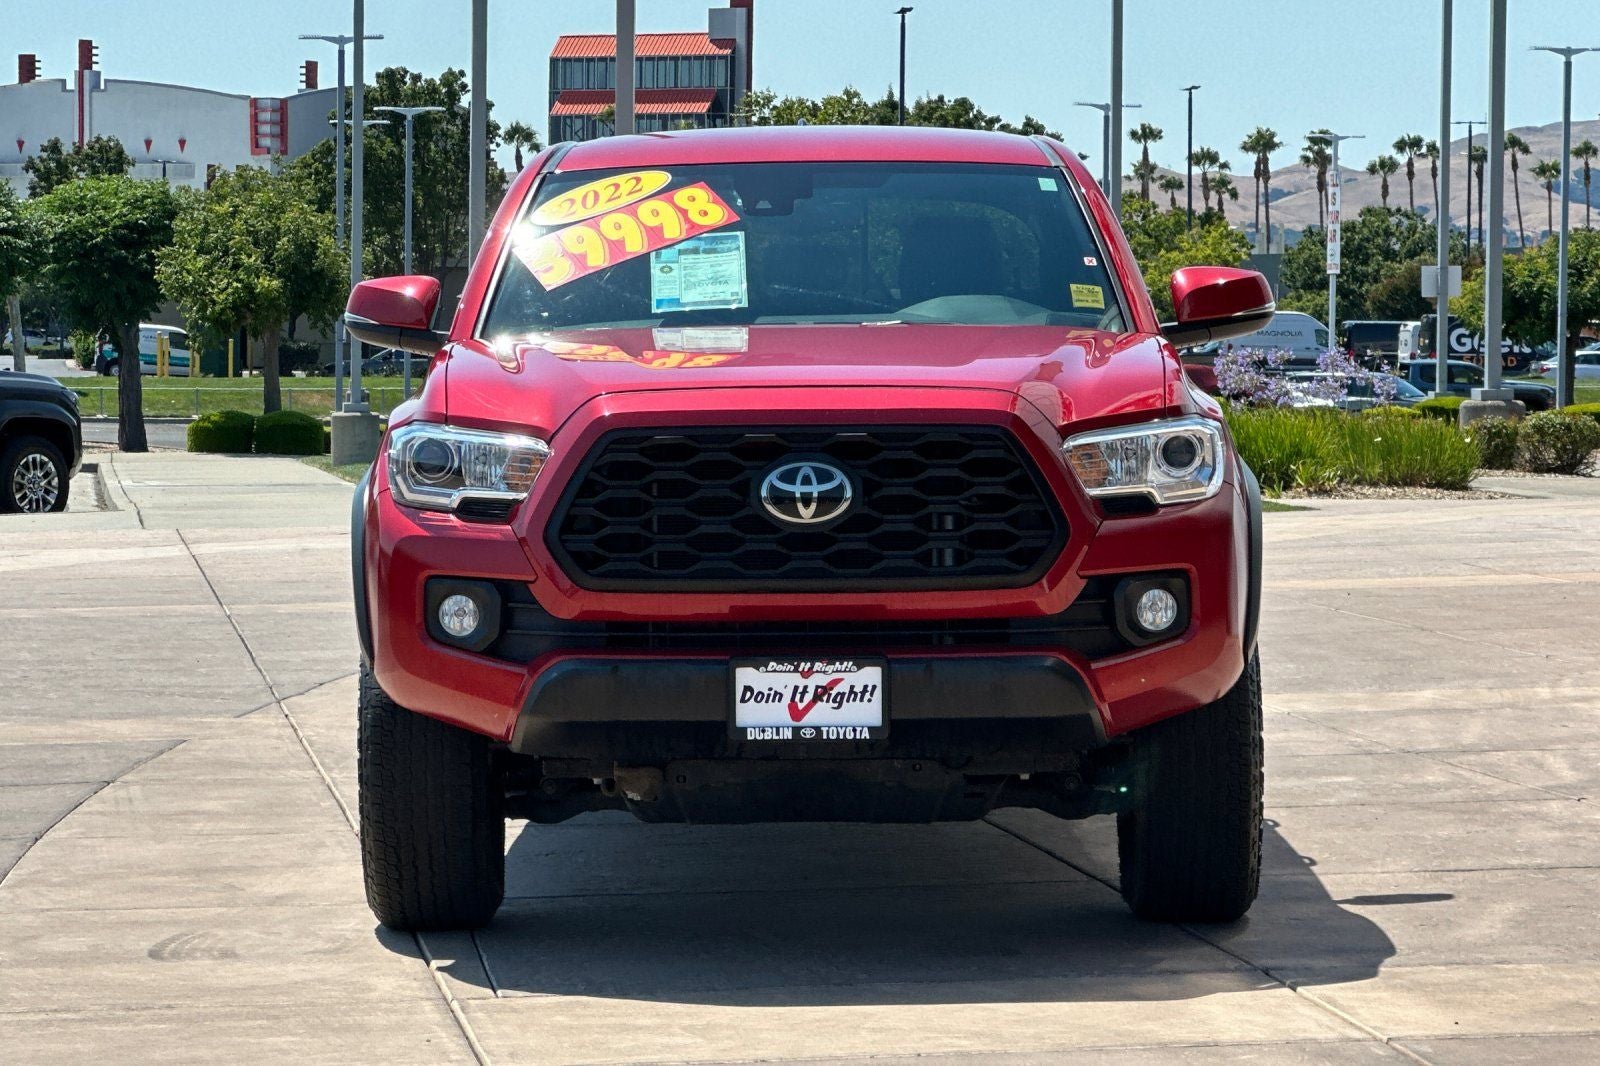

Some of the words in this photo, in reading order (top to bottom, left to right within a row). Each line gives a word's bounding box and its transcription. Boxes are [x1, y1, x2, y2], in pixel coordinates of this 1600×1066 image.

[559, 176, 644, 218] 2022
[531, 187, 727, 286] 39998
[766, 661, 798, 673] Doin'
[798, 662, 812, 672] It
[812, 661, 854, 675] Right!
[739, 684, 788, 704] Doin'
[789, 684, 809, 704] It
[811, 684, 877, 710] Right!
[746, 727, 793, 740] DUBLIN
[820, 726, 870, 740] TOYOTA
